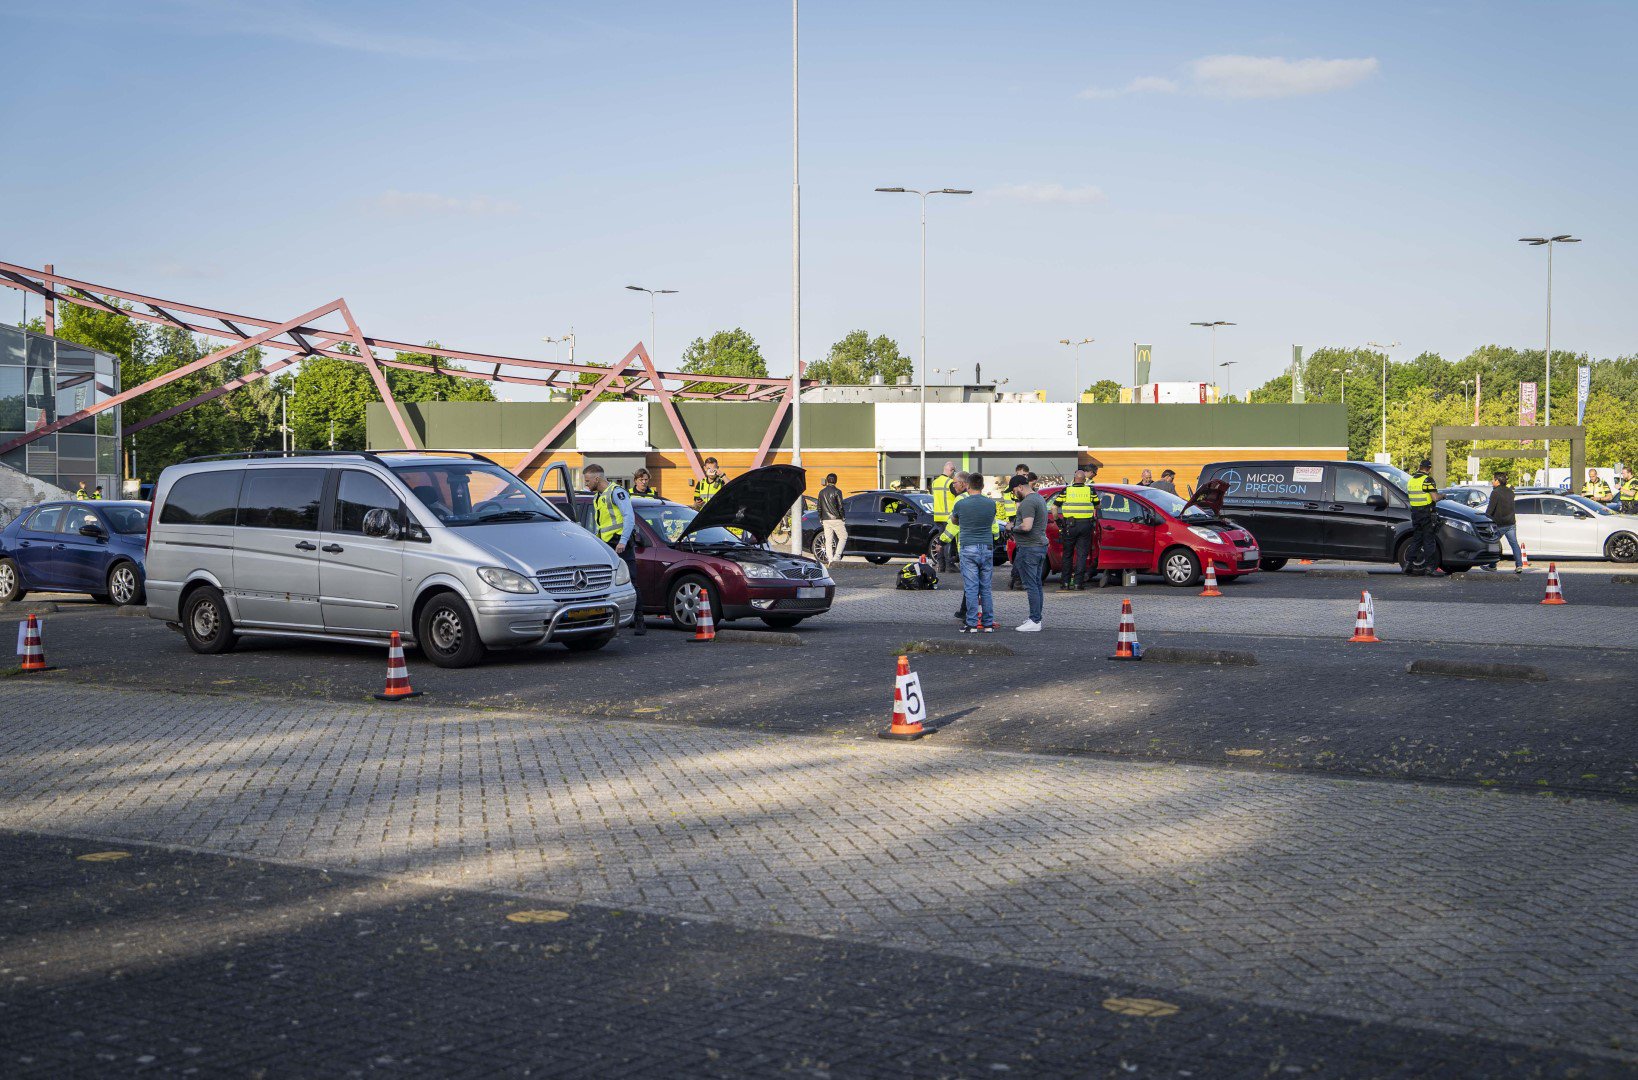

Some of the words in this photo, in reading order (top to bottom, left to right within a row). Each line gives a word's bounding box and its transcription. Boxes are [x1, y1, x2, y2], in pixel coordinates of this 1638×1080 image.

[1246, 473, 1285, 483] MICRO
[1245, 483, 1307, 494] PRECISION
[905, 680, 921, 715] 5
